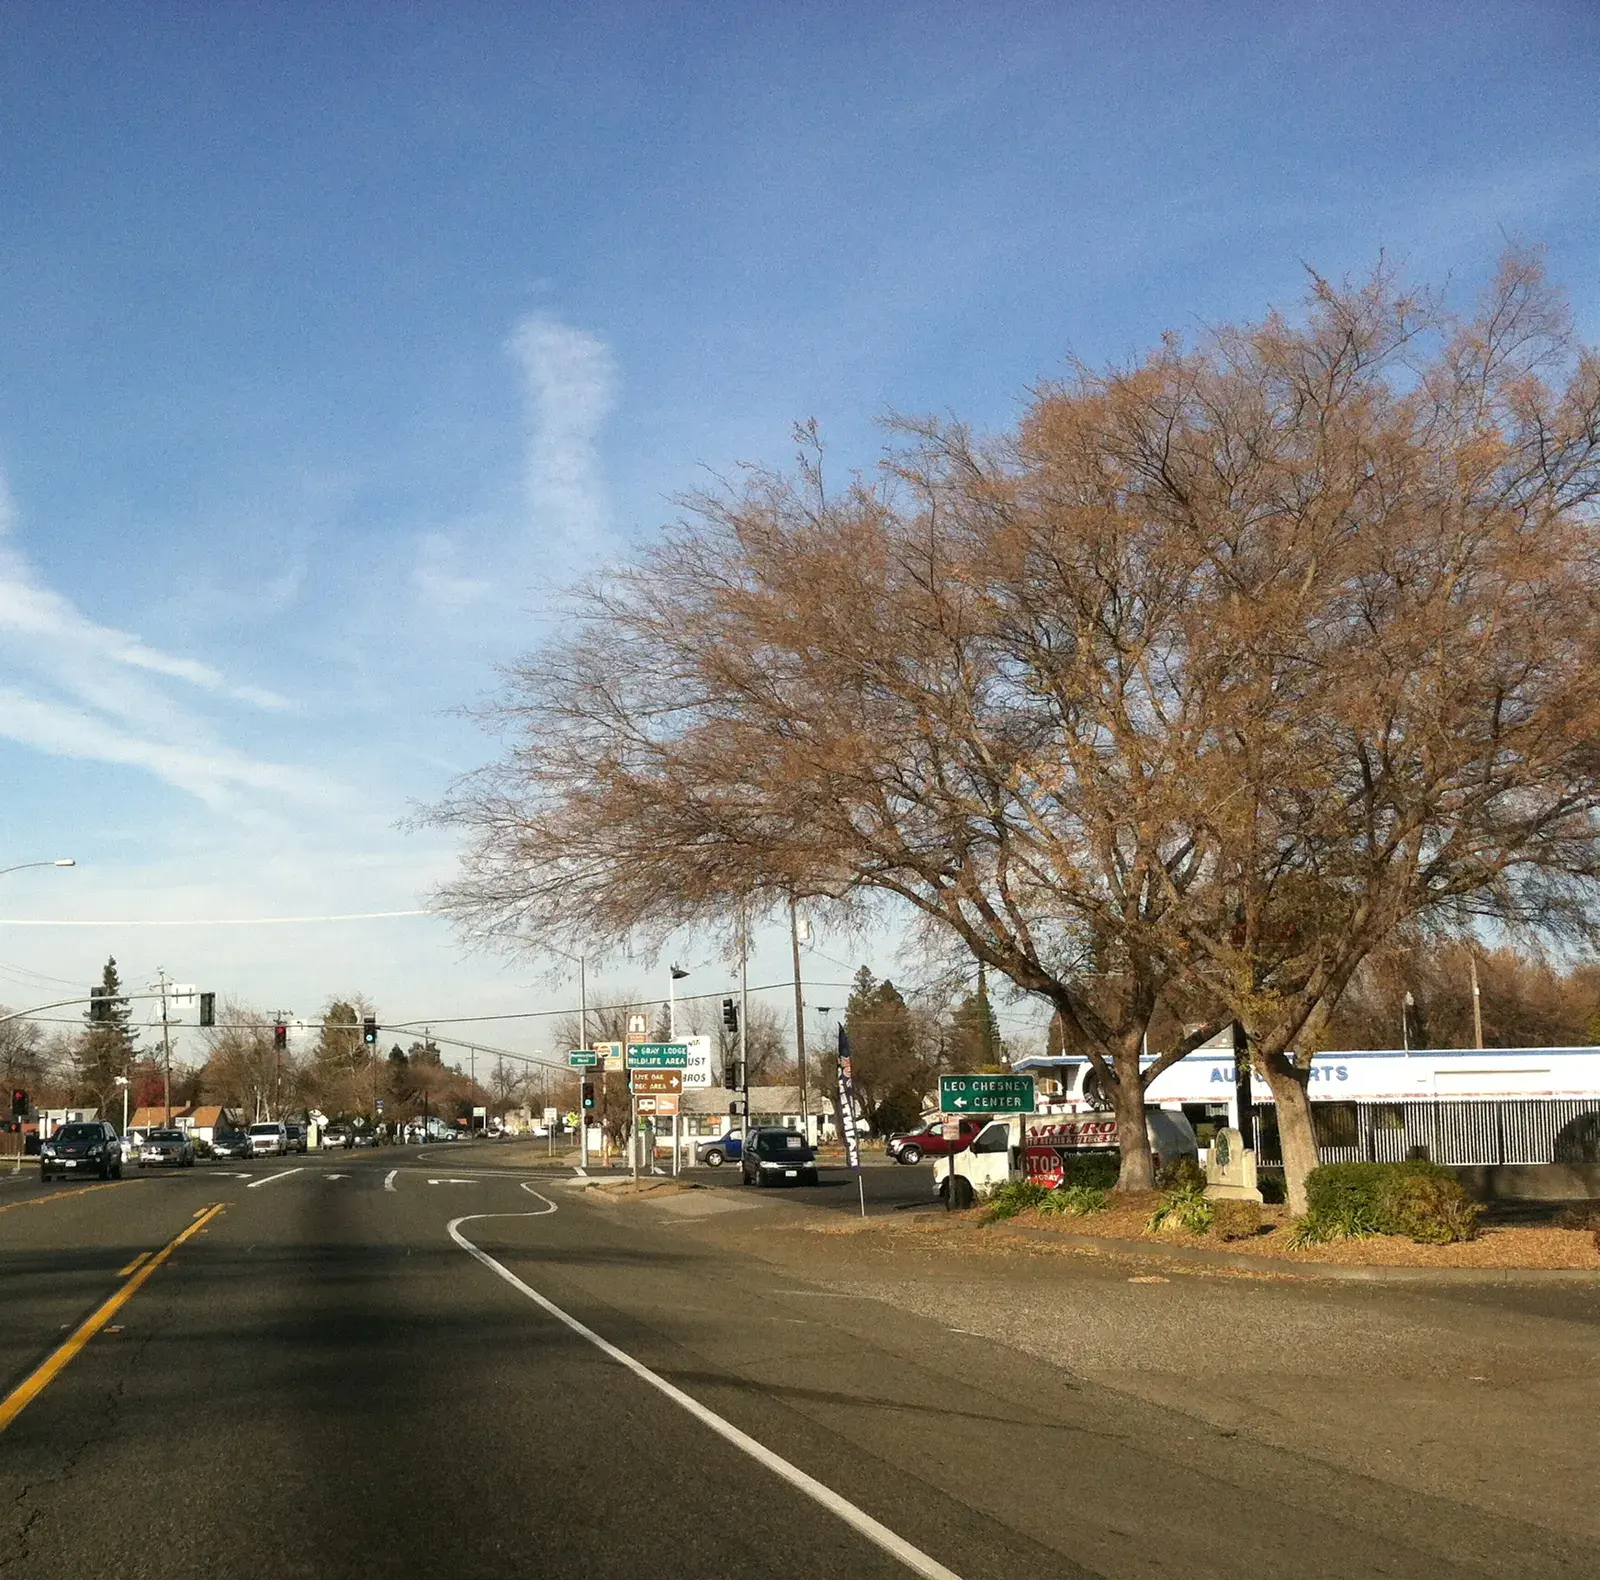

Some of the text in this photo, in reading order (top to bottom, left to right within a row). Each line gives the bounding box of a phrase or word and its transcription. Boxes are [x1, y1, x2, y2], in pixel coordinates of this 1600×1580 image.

[641, 1047, 687, 1055] GRAY LODGE
[628, 1057, 662, 1065] WILDLIFE
[665, 1057, 686, 1065] AREA
[1309, 1066, 1349, 1081] RTS
[944, 1081, 1029, 1091] LEO CHESNEY
[973, 1097, 1021, 1107] CENTER
